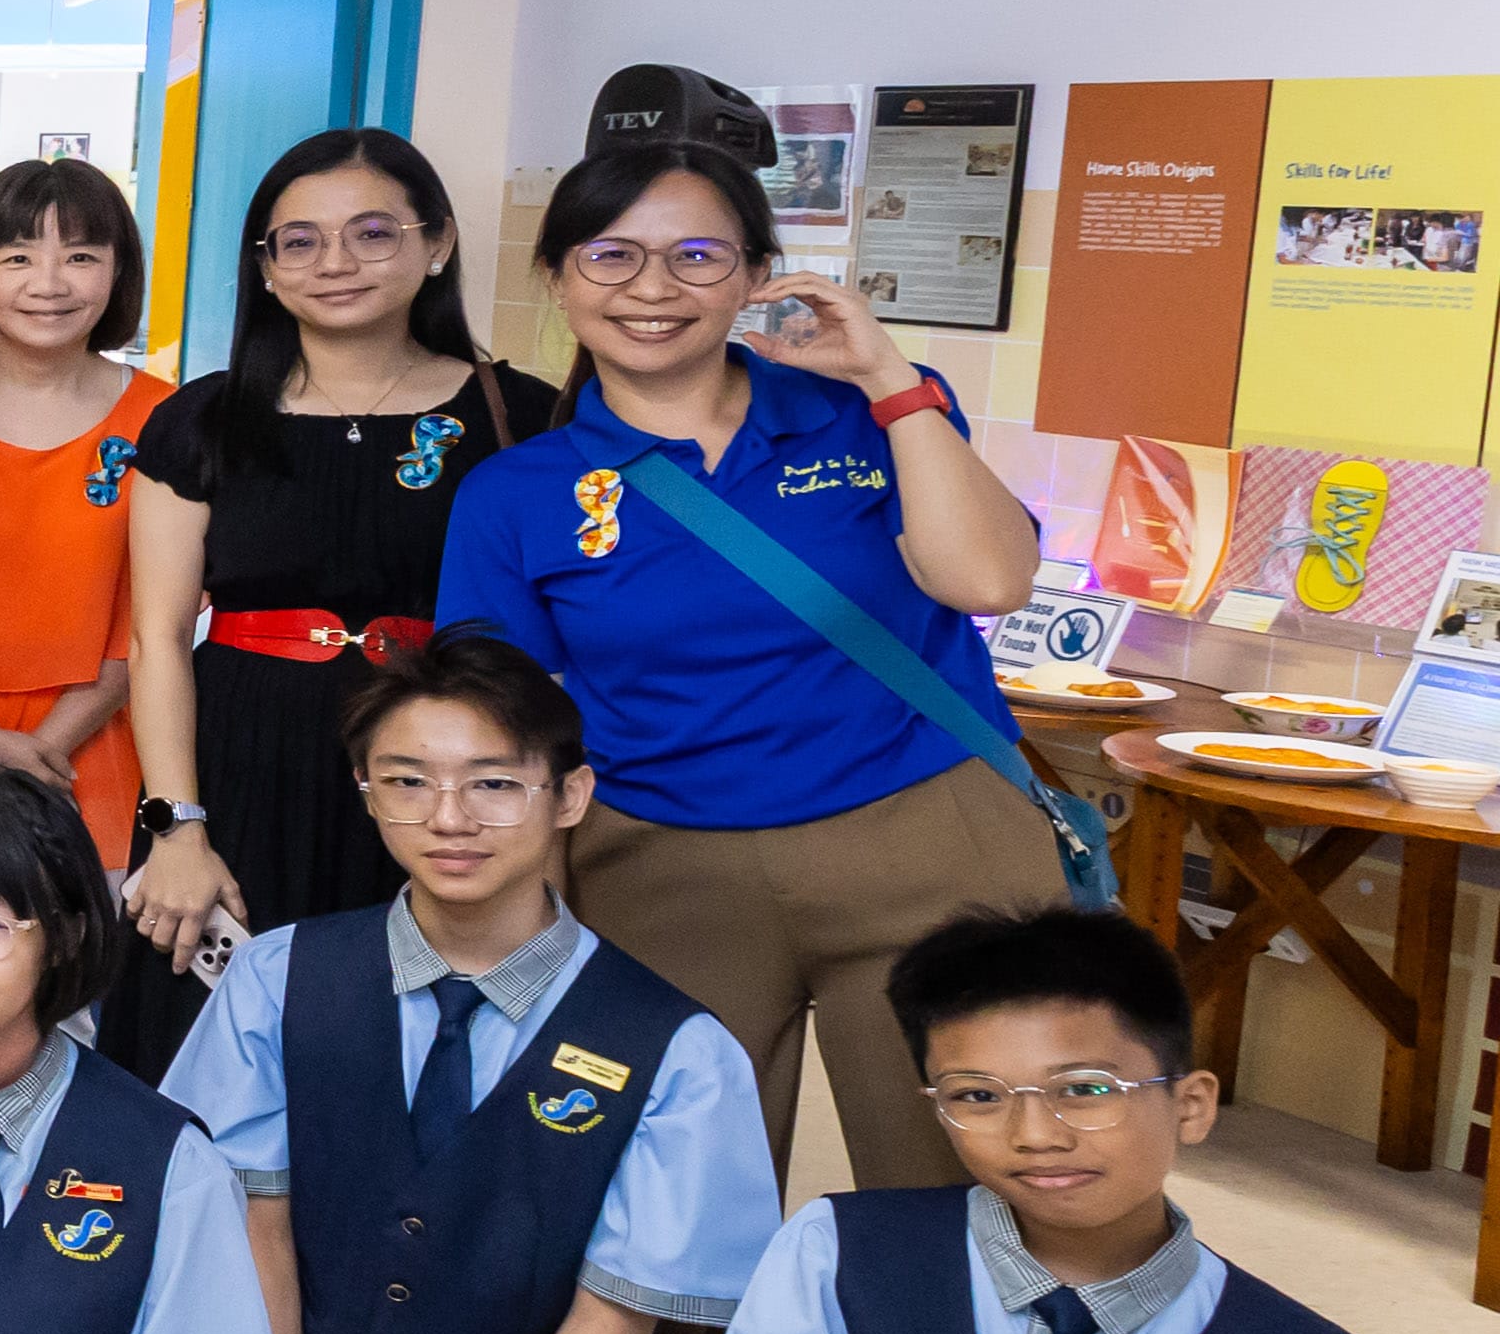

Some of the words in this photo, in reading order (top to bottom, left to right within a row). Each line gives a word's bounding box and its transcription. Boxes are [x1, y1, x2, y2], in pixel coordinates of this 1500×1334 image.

[1086, 161, 1124, 177] Home
[1126, 161, 1161, 177] Skills
[1163, 160, 1216, 183] Origins
[1285, 163, 1323, 179] Skills
[1328, 164, 1352, 179] for
[1355, 164, 1392, 180] Life!
[1005, 616, 1022, 630] Do
[1023, 620, 1046, 635] Not
[998, 635, 1037, 654] Touch
